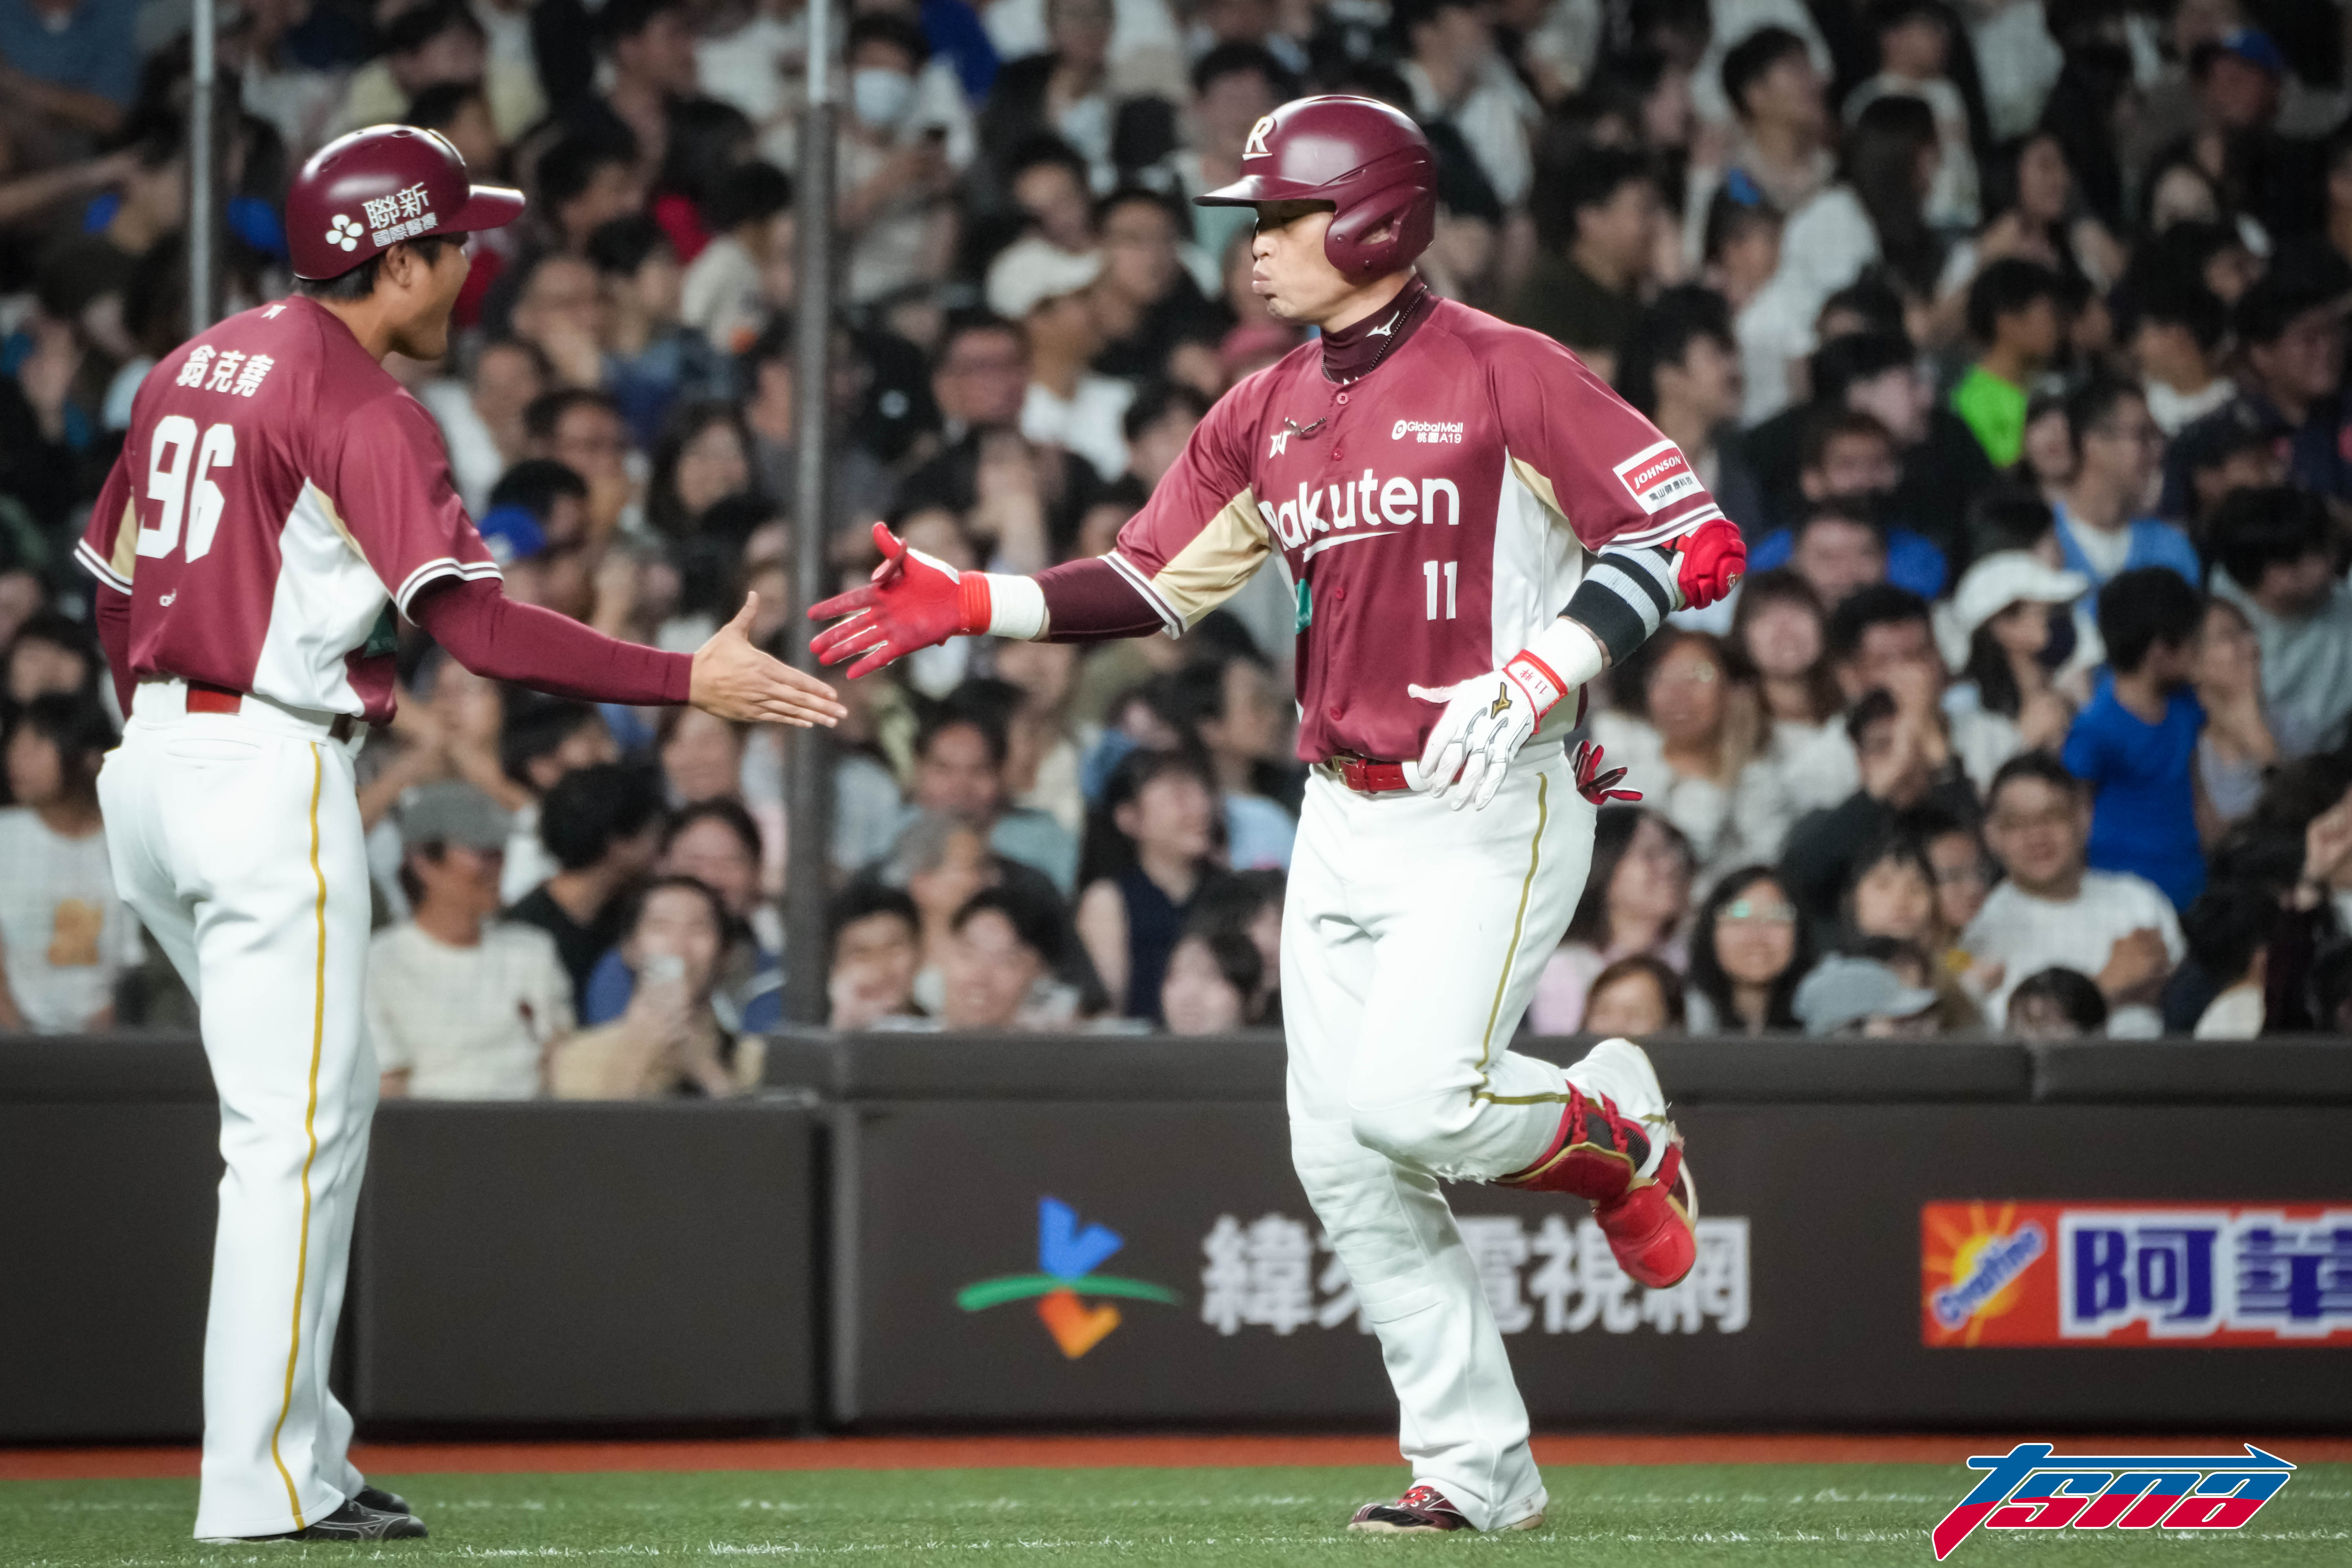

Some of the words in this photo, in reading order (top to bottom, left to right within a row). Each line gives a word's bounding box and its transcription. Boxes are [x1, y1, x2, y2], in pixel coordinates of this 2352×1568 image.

[1244, 117, 1276, 154] R
[361, 182, 429, 229] 聯新
[176, 344, 274, 397] 翁克堯
[135, 415, 236, 564] 96
[1634, 456, 1681, 490] JOHNSON
[1423, 561, 1458, 620] 11
